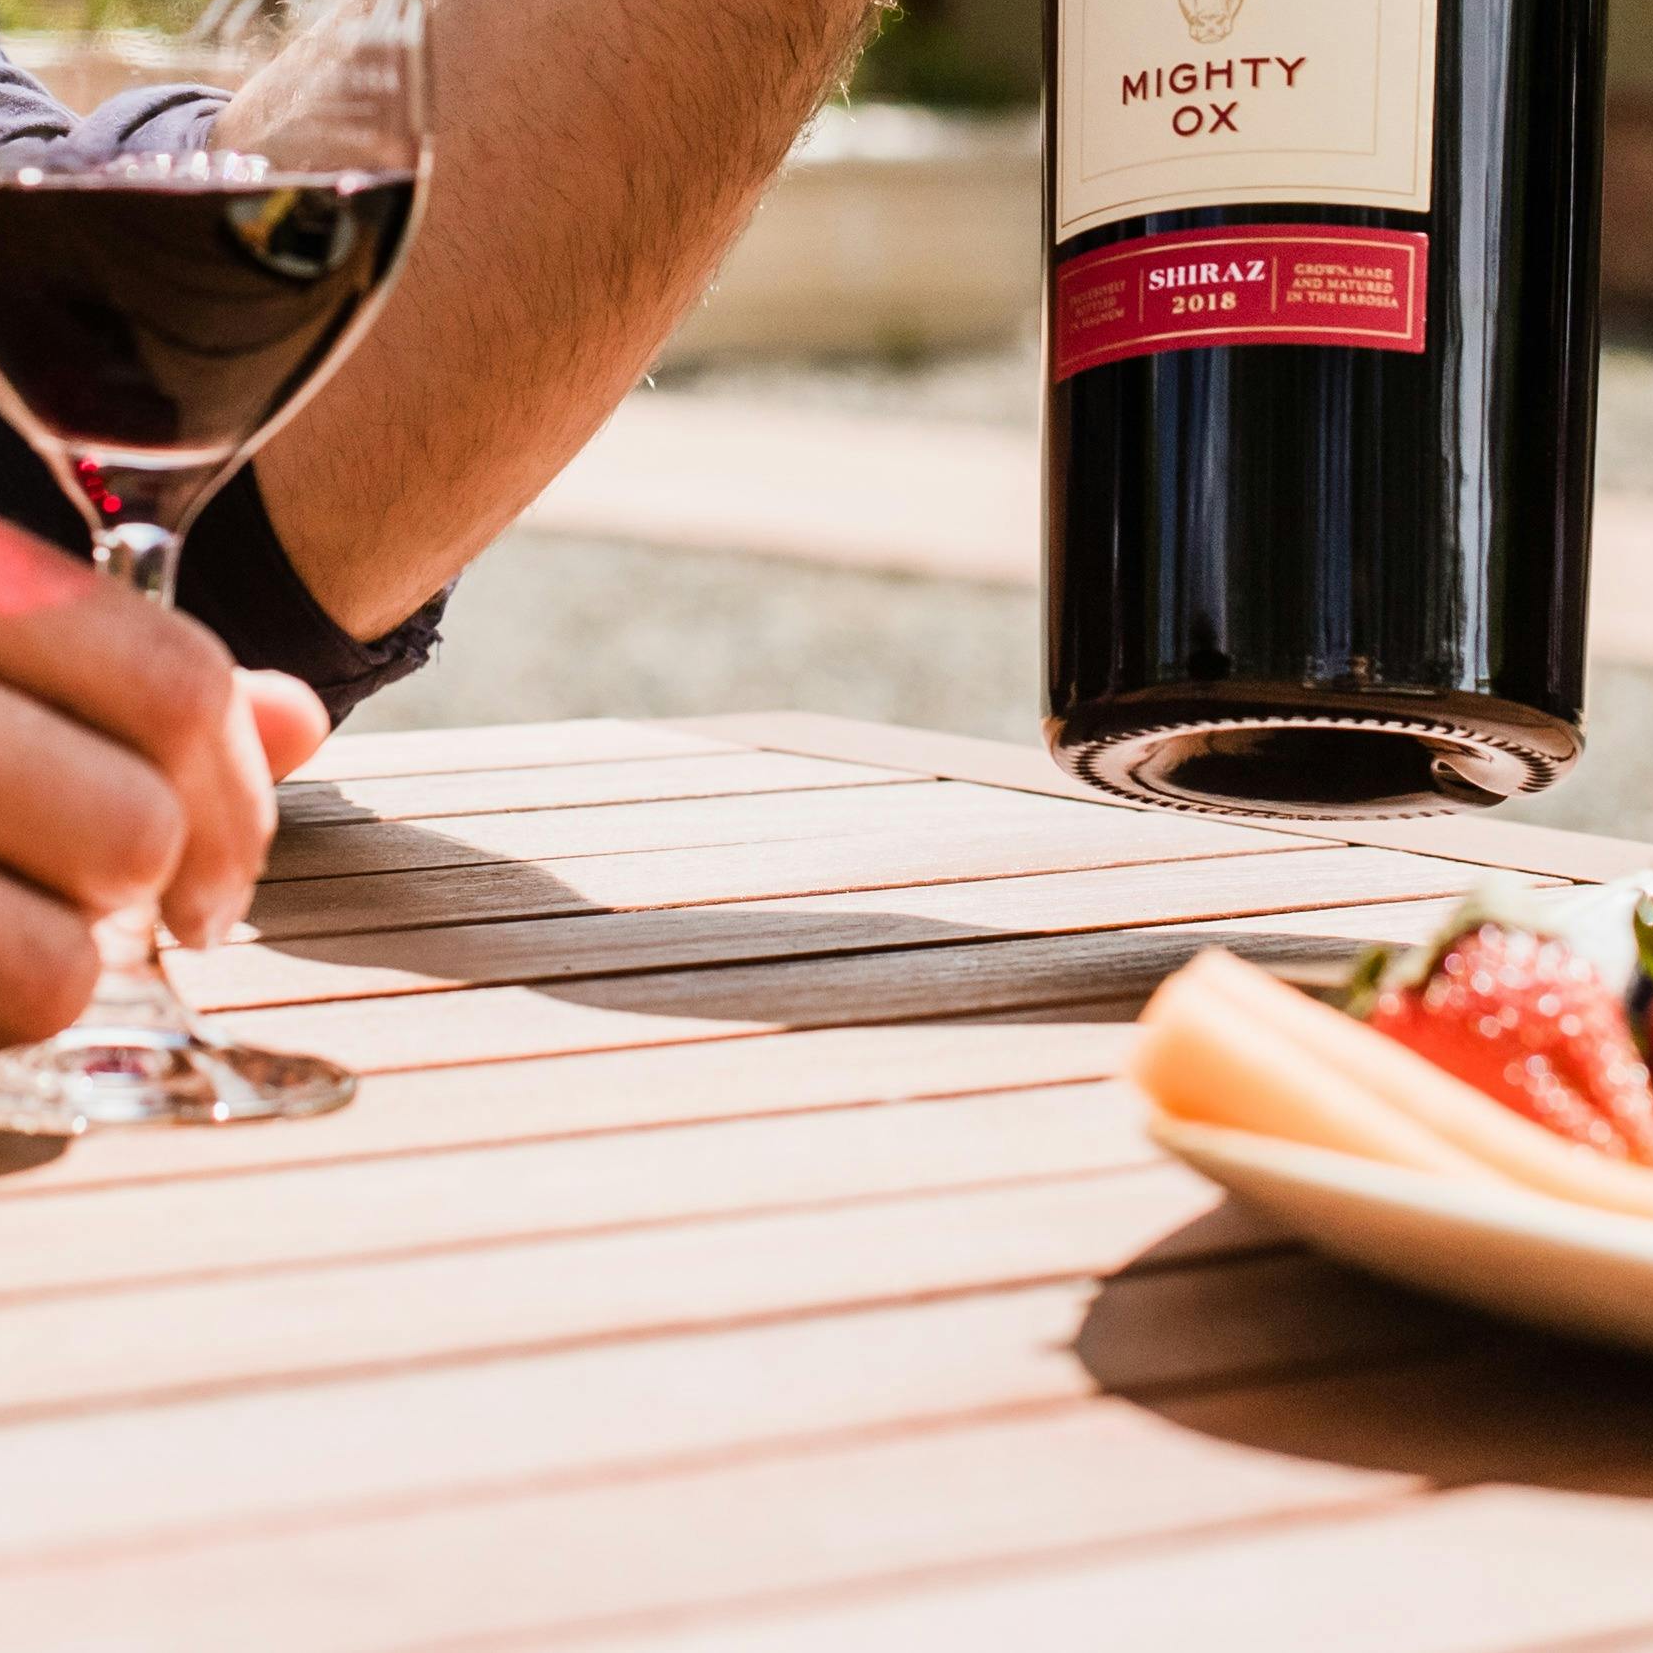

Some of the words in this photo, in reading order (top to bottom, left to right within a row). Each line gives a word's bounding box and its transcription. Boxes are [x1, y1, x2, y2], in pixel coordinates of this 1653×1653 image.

[1121, 56, 1307, 106] MIGHTY
[1171, 101, 1239, 137] OX
[1148, 260, 1266, 291] SHIRAZ
[1353, 266, 1393, 281] MADE
[1291, 277, 1324, 290] AND
[1327, 278, 1395, 295] MATURED
[1171, 291, 1237, 314] 2018
[1286, 291, 1303, 304] IN
[1307, 291, 1336, 304] THE
[1339, 292, 1399, 309] BAROSSA
